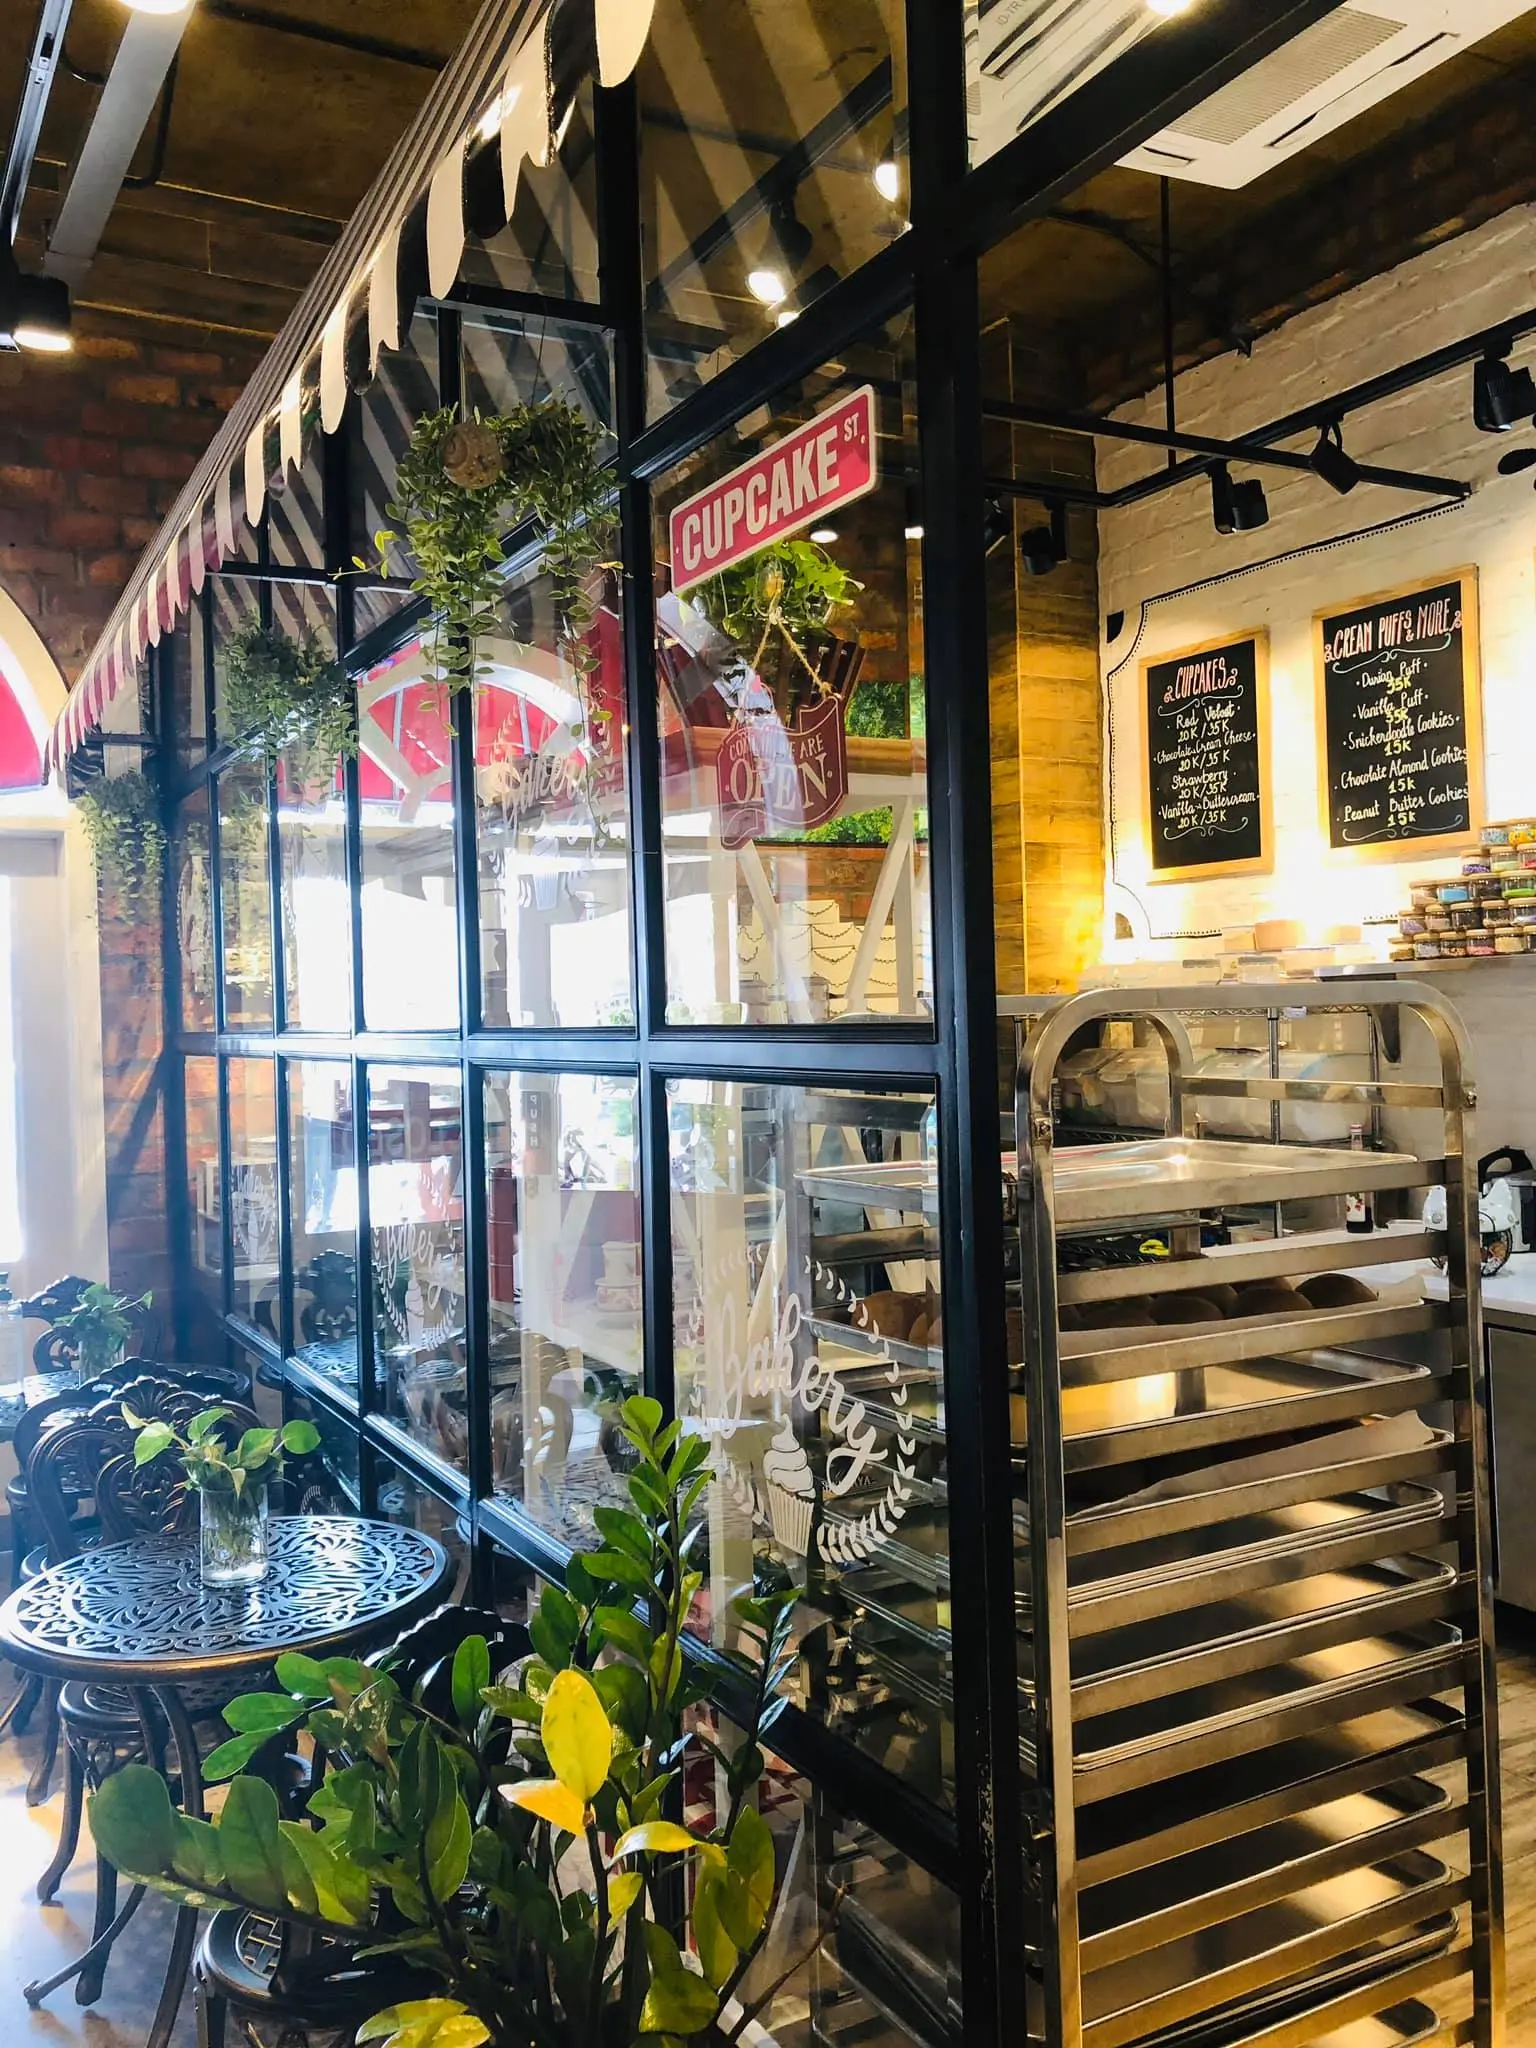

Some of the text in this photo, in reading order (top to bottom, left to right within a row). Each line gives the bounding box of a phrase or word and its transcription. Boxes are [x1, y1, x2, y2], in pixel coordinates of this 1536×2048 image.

[682, 425, 840, 571] CUPCAKE
[1333, 621, 1372, 660] CREAM
[1378, 610, 1412, 649] PUFFS
[1416, 598, 1451, 640] MORE
[1175, 656, 1227, 700] CUPCAKES
[1361, 658, 1422, 688] Durian Puff
[1176, 701, 1235, 729] Red Velvet
[1357, 688, 1424, 720] Vanilla Puff
[1417, 711, 1455, 732] Cookies
[800, 732, 824, 759] ARE
[1223, 730, 1253, 745] Cheese
[1171, 769, 1228, 790] Strawberry
[1341, 745, 1467, 789] Chocolate Almond Cookies
[1161, 791, 1256, 821] Vanilla Buttercream
[1343, 783, 1468, 823] Peanut Butter Cookies
